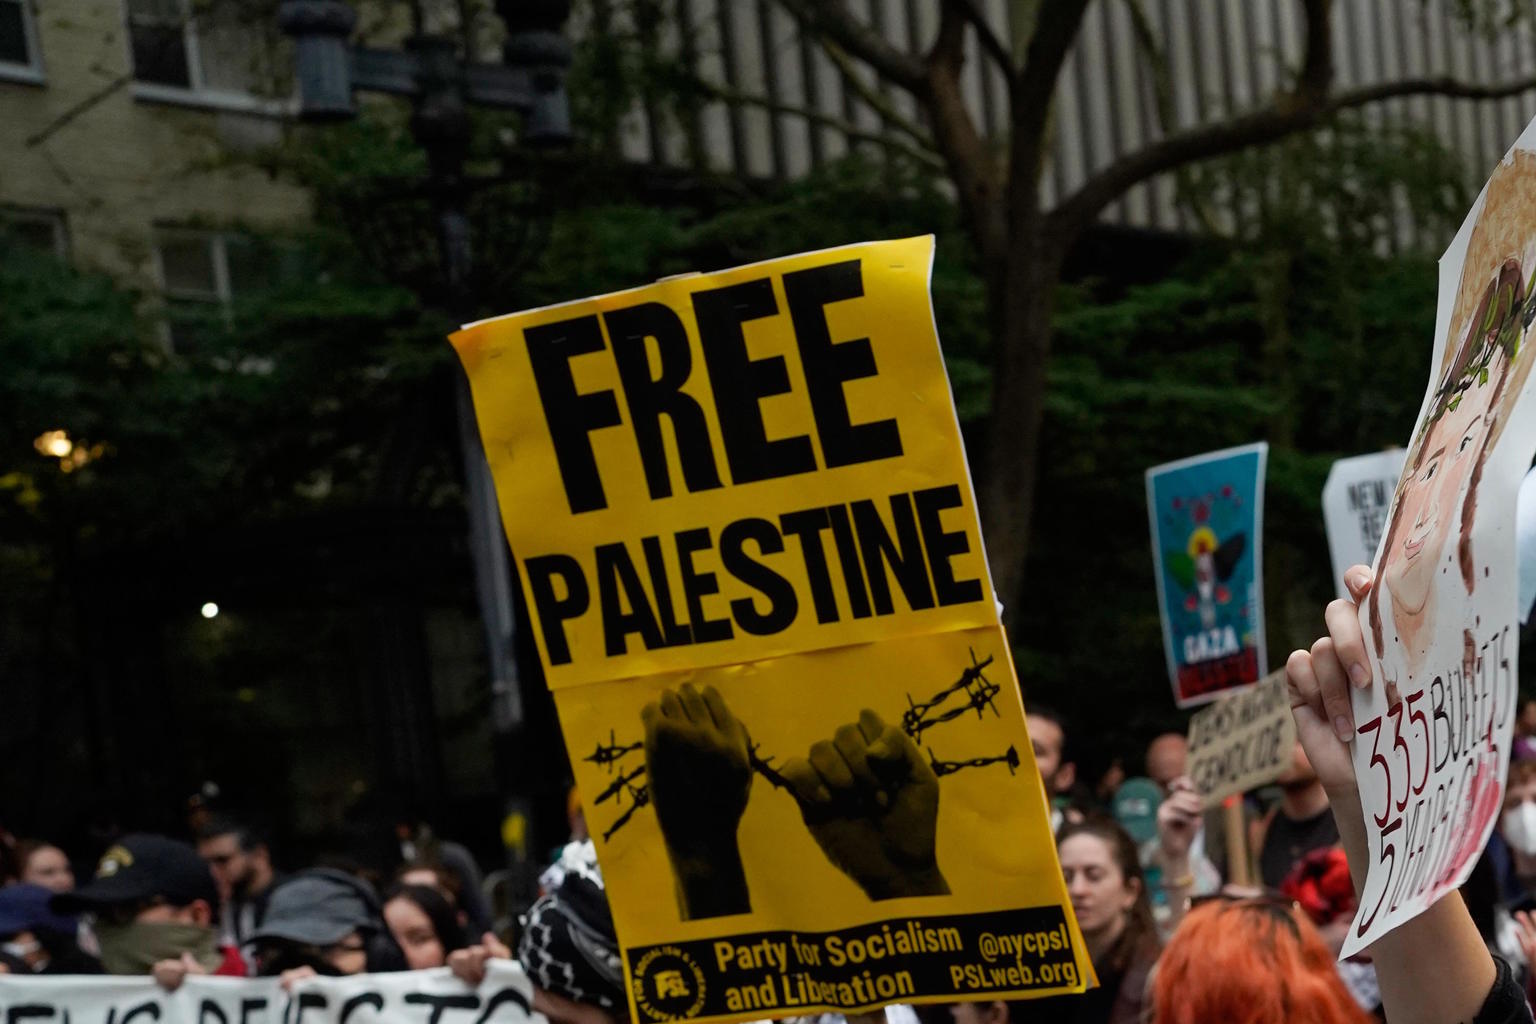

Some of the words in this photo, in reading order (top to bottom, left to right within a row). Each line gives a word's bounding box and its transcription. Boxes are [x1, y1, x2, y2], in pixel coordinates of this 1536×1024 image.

[523, 259, 903, 515] FREE
[525, 484, 984, 666] PALESTINE
[1357, 689, 1431, 830] 335
[1430, 625, 1514, 775] BULLETS
[1357, 816, 1403, 939] 5
[713, 938, 788, 974] Party
[791, 934, 822, 966] for
[825, 921, 963, 968] Socialism
[978, 922, 1070, 963] @nycpsl
[653, 969, 690, 1000] PSL
[725, 975, 775, 1012] and
[780, 970, 915, 1009] Liberation
[949, 962, 1079, 989] PSLweb.org
